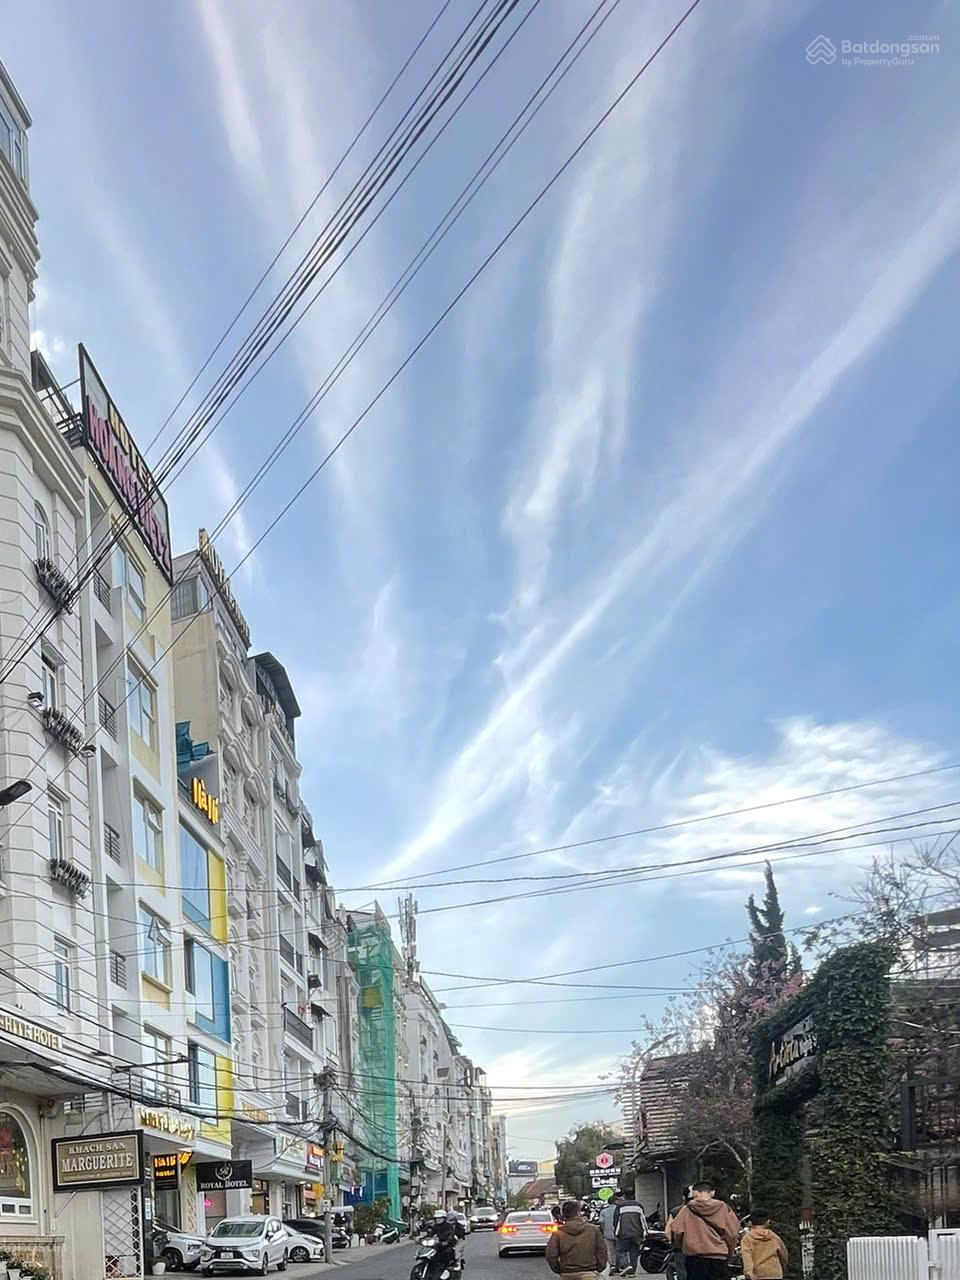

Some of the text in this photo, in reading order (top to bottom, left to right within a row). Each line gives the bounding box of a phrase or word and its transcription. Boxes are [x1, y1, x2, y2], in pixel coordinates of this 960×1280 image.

[61, 1152, 134, 1173] MARGUERITE
[200, 1180, 249, 1190] ROYAL HOTEL
